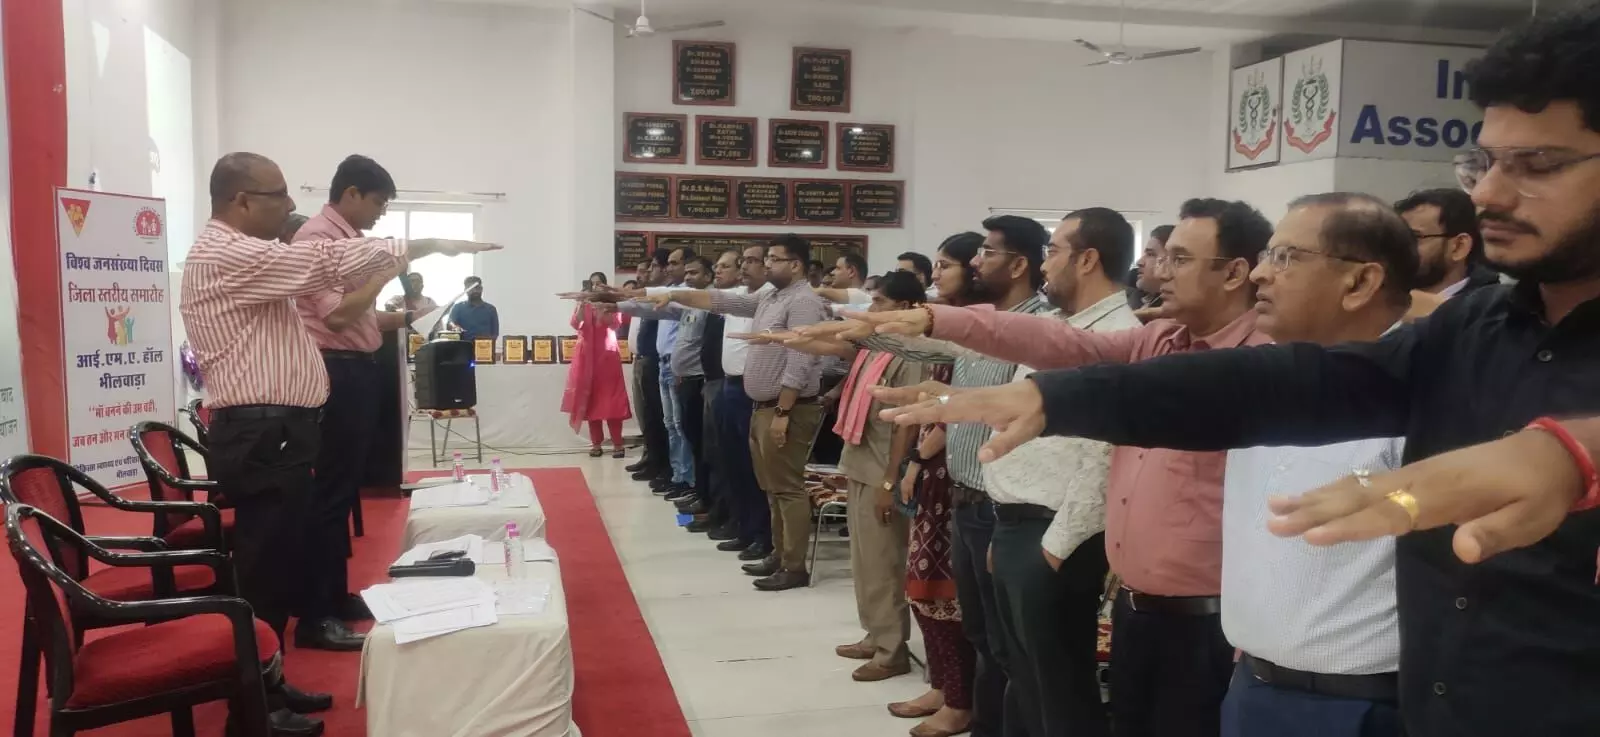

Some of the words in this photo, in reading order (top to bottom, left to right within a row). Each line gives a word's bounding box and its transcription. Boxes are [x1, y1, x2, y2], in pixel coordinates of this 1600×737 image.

[66, 252, 91, 270] विश्व
[92, 253, 138, 271] जनसंख्या
[139, 255, 164, 272] दिवस
[68, 281, 96, 303] जिला
[97, 282, 129, 303] स्तरीय
[130, 284, 164, 303] समारोह
[142, 347, 163, 363] हॉल
[99, 373, 146, 390] भीलवाड़ा
